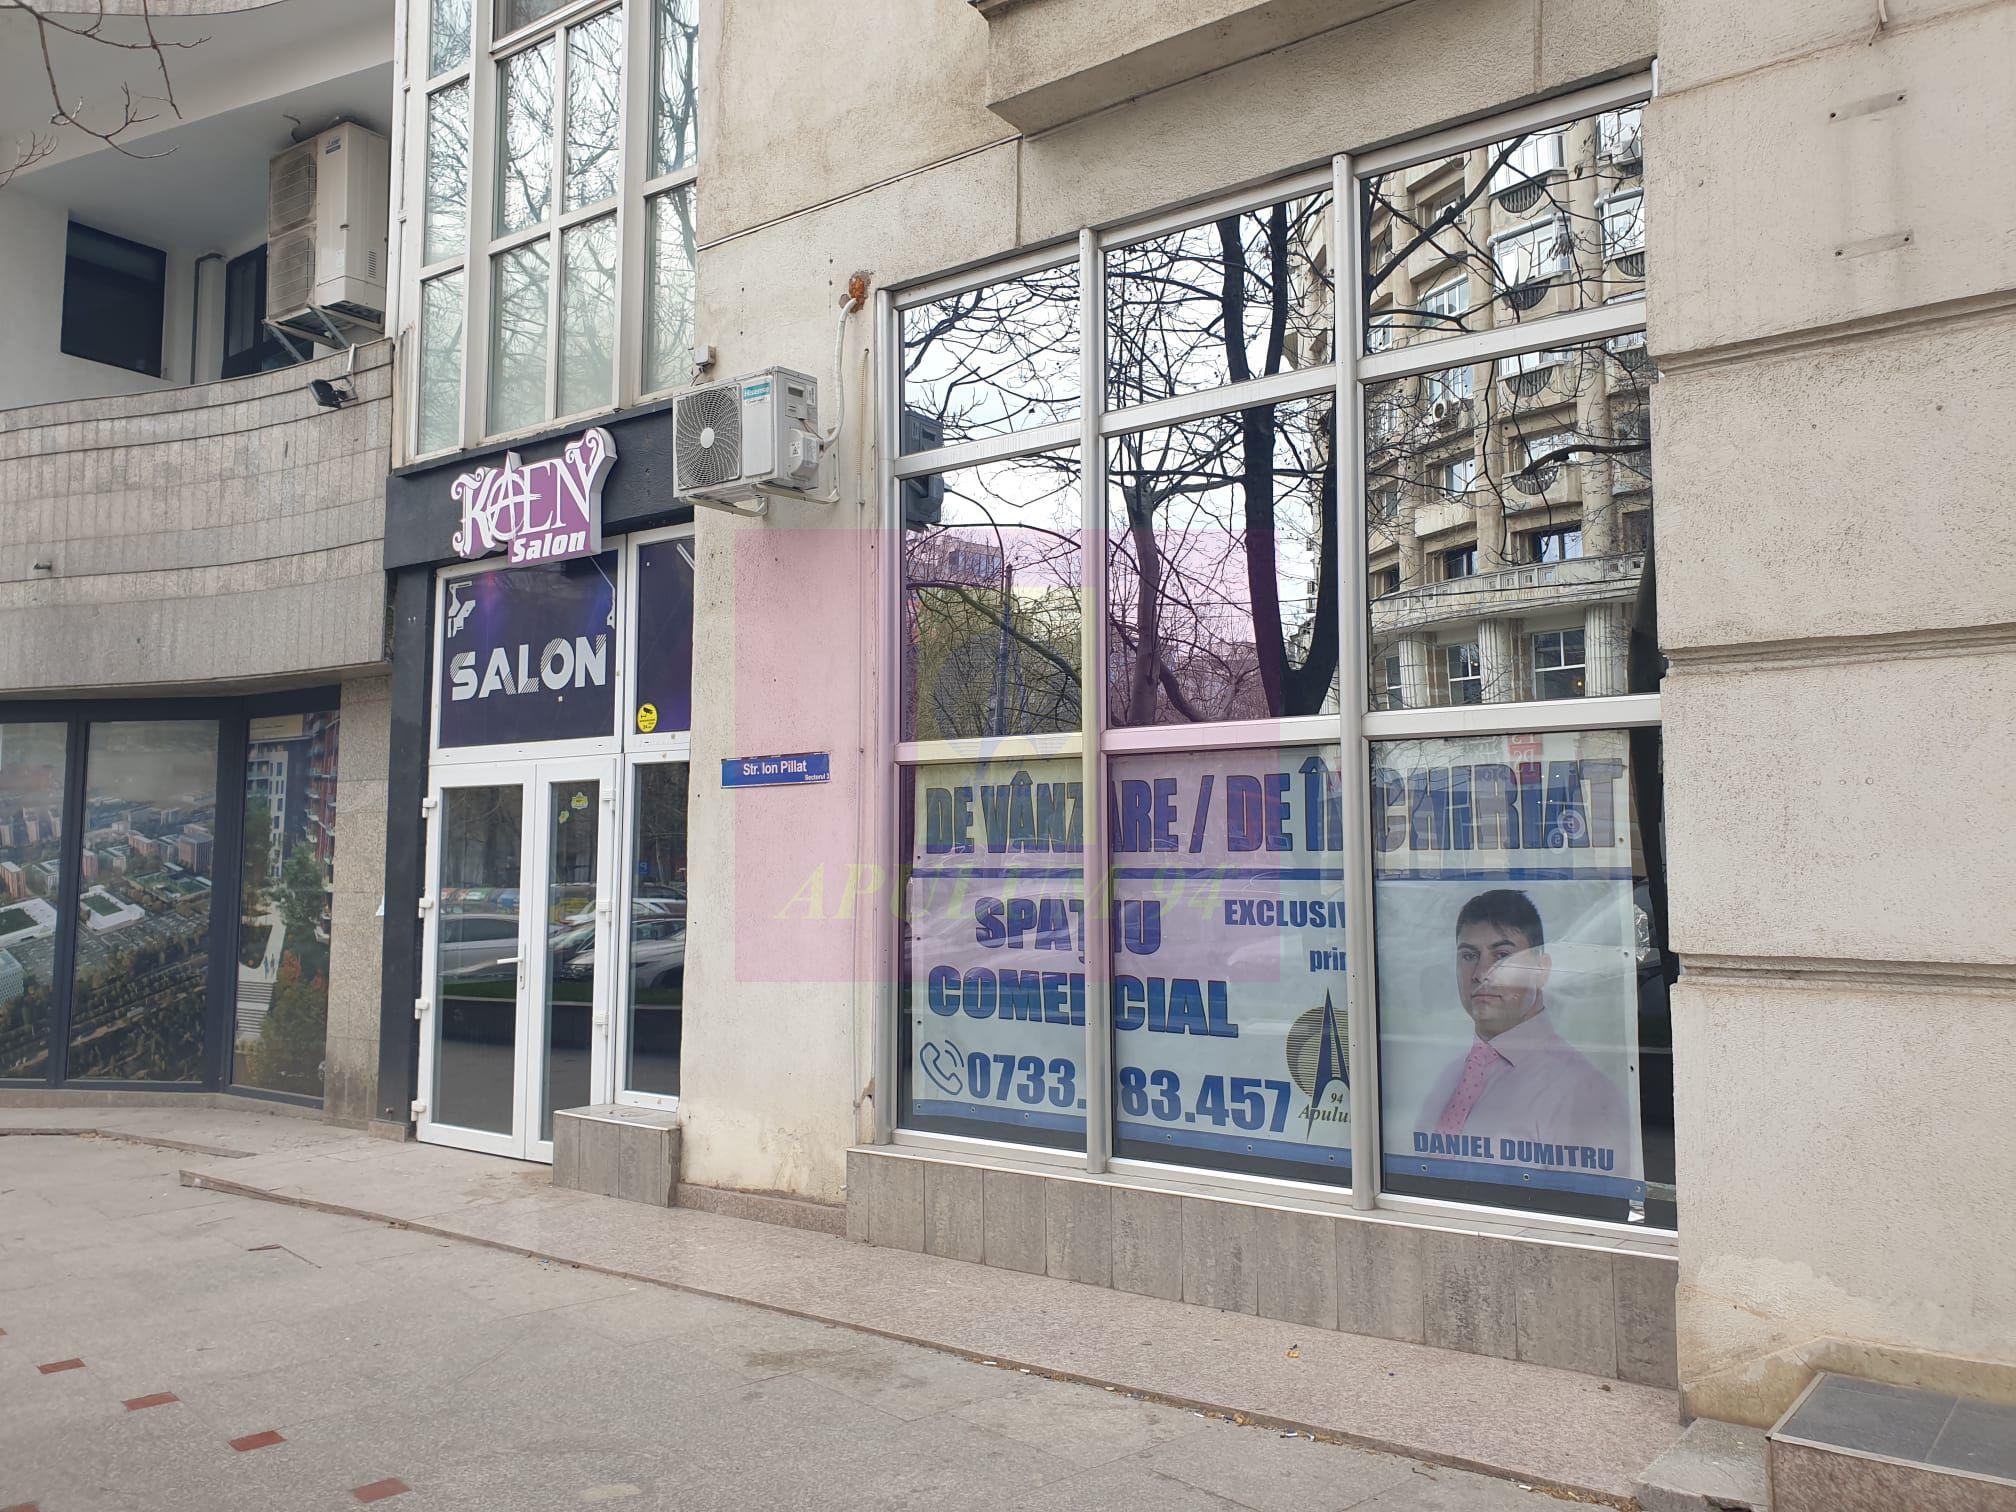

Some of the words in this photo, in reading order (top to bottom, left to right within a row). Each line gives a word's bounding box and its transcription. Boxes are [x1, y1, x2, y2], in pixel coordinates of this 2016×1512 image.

[511, 530, 586, 563] Salon
[449, 634, 607, 701] SALON
[743, 762, 760, 776] Str.
[762, 761, 778, 775] Ion
[780, 759, 807, 773] Pillat
[925, 786, 974, 854] DE
[1189, 775, 1215, 853] /
[1227, 773, 1293, 852] DE
[967, 1052, 1291, 1133] 0733.83.457
[1331, 1092, 1344, 1104] 94
[1297, 1103, 1351, 1124] Apulu
[1413, 1131, 1495, 1159] DANIEL
[1500, 1138, 1614, 1171] DUMITRU
